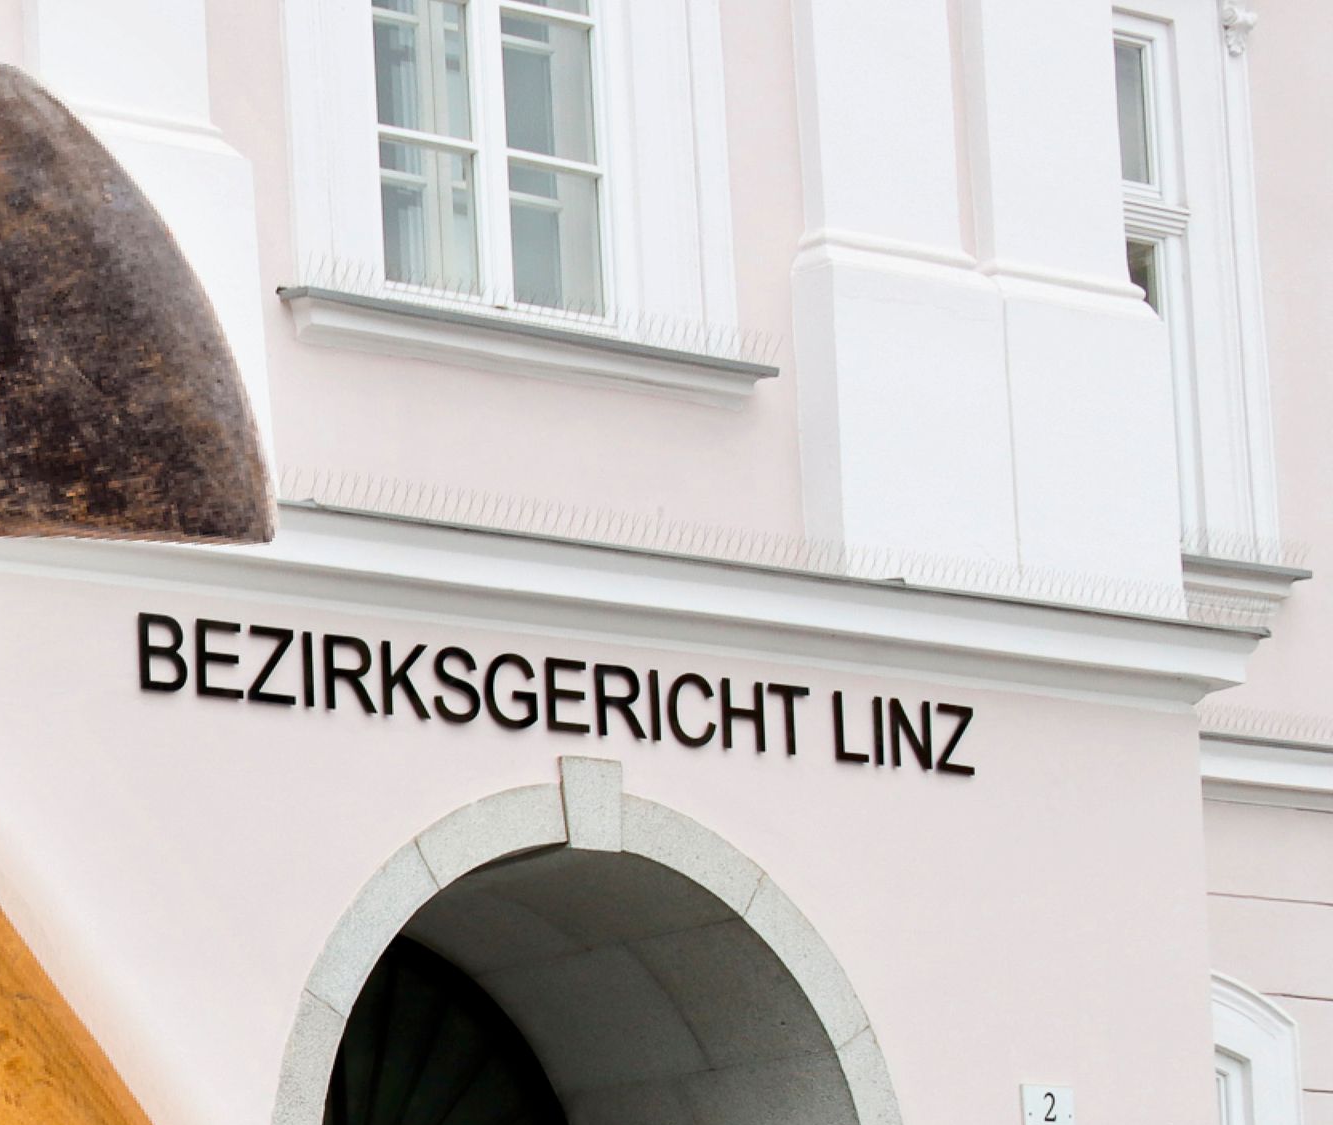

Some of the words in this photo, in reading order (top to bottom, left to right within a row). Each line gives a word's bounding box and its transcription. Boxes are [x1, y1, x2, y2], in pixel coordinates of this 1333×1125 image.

[137, 612, 809, 756] BEZIRKSGERICHT
[833, 690, 975, 776] LINZ
[1044, 1092, 1057, 1121] 2
